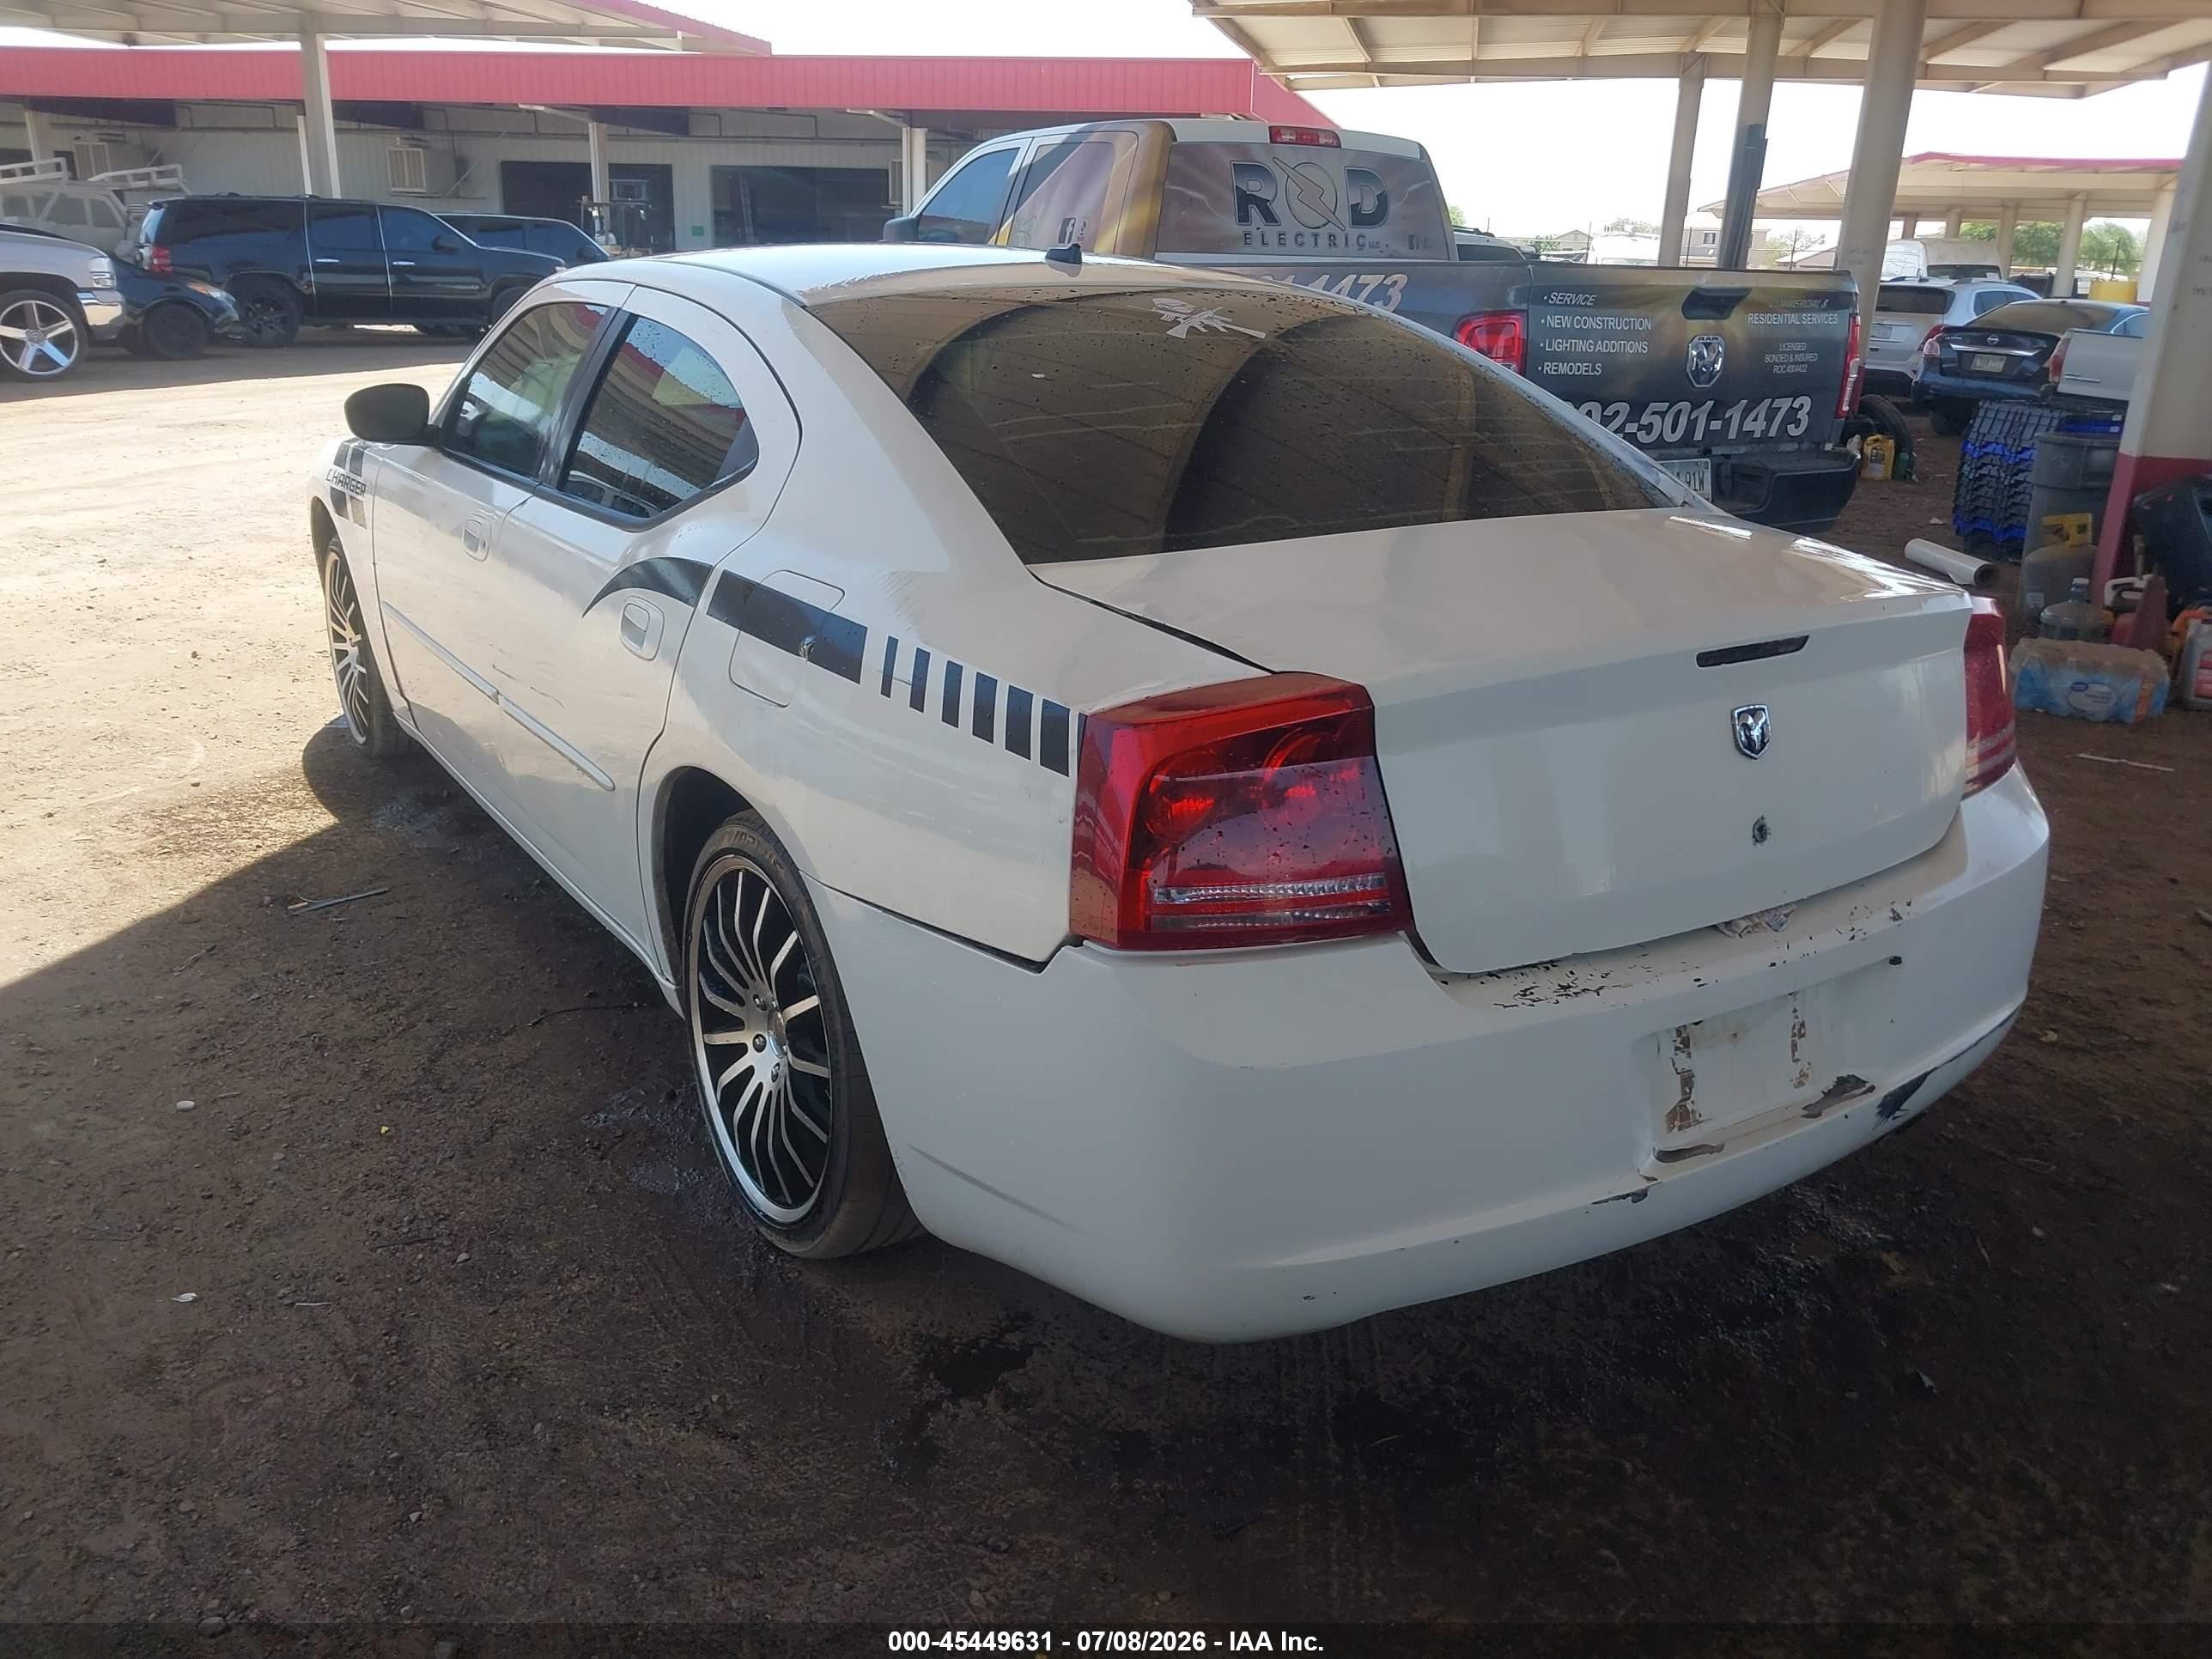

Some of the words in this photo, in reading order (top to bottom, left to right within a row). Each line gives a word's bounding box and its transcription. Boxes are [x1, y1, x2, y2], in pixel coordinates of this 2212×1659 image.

[1243, 232, 1367, 248] ELECTRIC
[1548, 292, 1597, 305] SERVICE
[1547, 315, 1572, 328] NEW
[1573, 316, 1652, 331] CONSTRUCTION
[1747, 313, 1800, 325] RESIDENTIAL
[1802, 313, 1838, 325] SERVICES
[1546, 339, 1594, 352] LIGHTING
[1595, 341, 1649, 354] ADDITIONS
[1543, 362, 1602, 375] REMODELS
[1565, 396, 1812, 444] 02-501-1473
[325, 468, 367, 497] CHARGER
